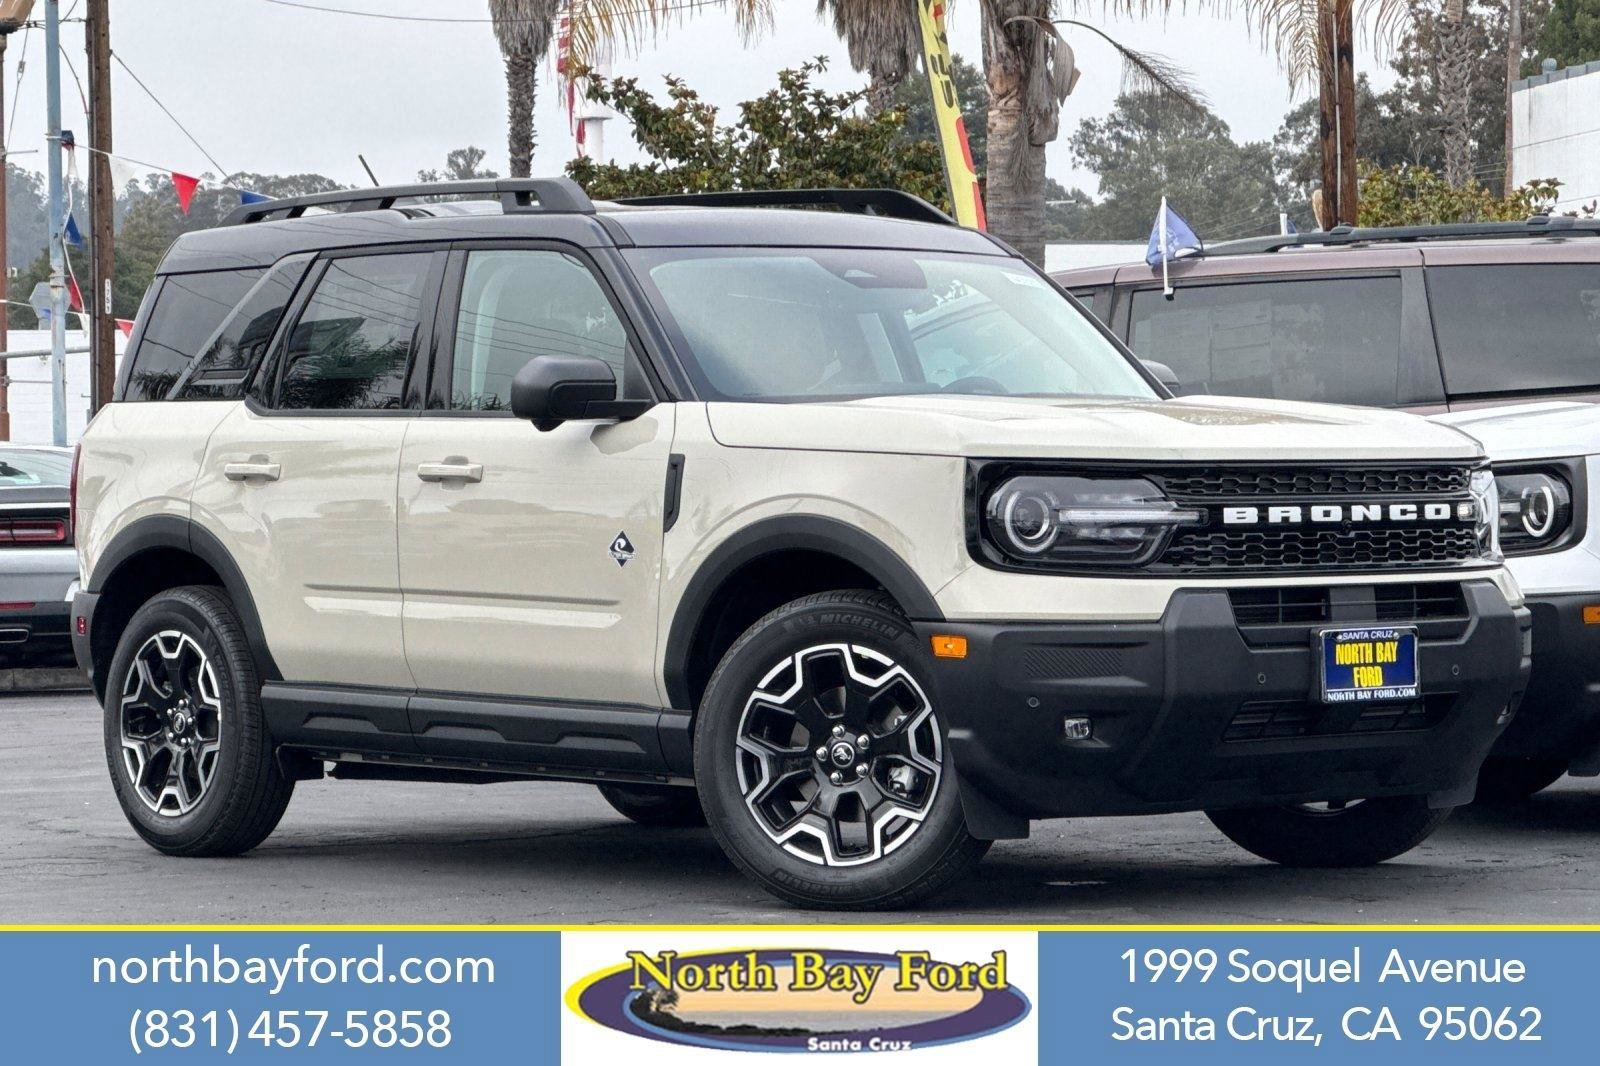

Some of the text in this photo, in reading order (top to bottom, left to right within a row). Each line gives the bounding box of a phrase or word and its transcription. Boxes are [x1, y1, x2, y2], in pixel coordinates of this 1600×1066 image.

[1223, 504, 1451, 524] BRONCO
[820, 613, 899, 637] MICHELIN
[1342, 630, 1394, 640] SANTA CRUZ
[1335, 642, 1398, 665] NORTH BAY
[1353, 666, 1383, 687] FORD
[1327, 688, 1416, 701] NORTH BAY FORD.COM
